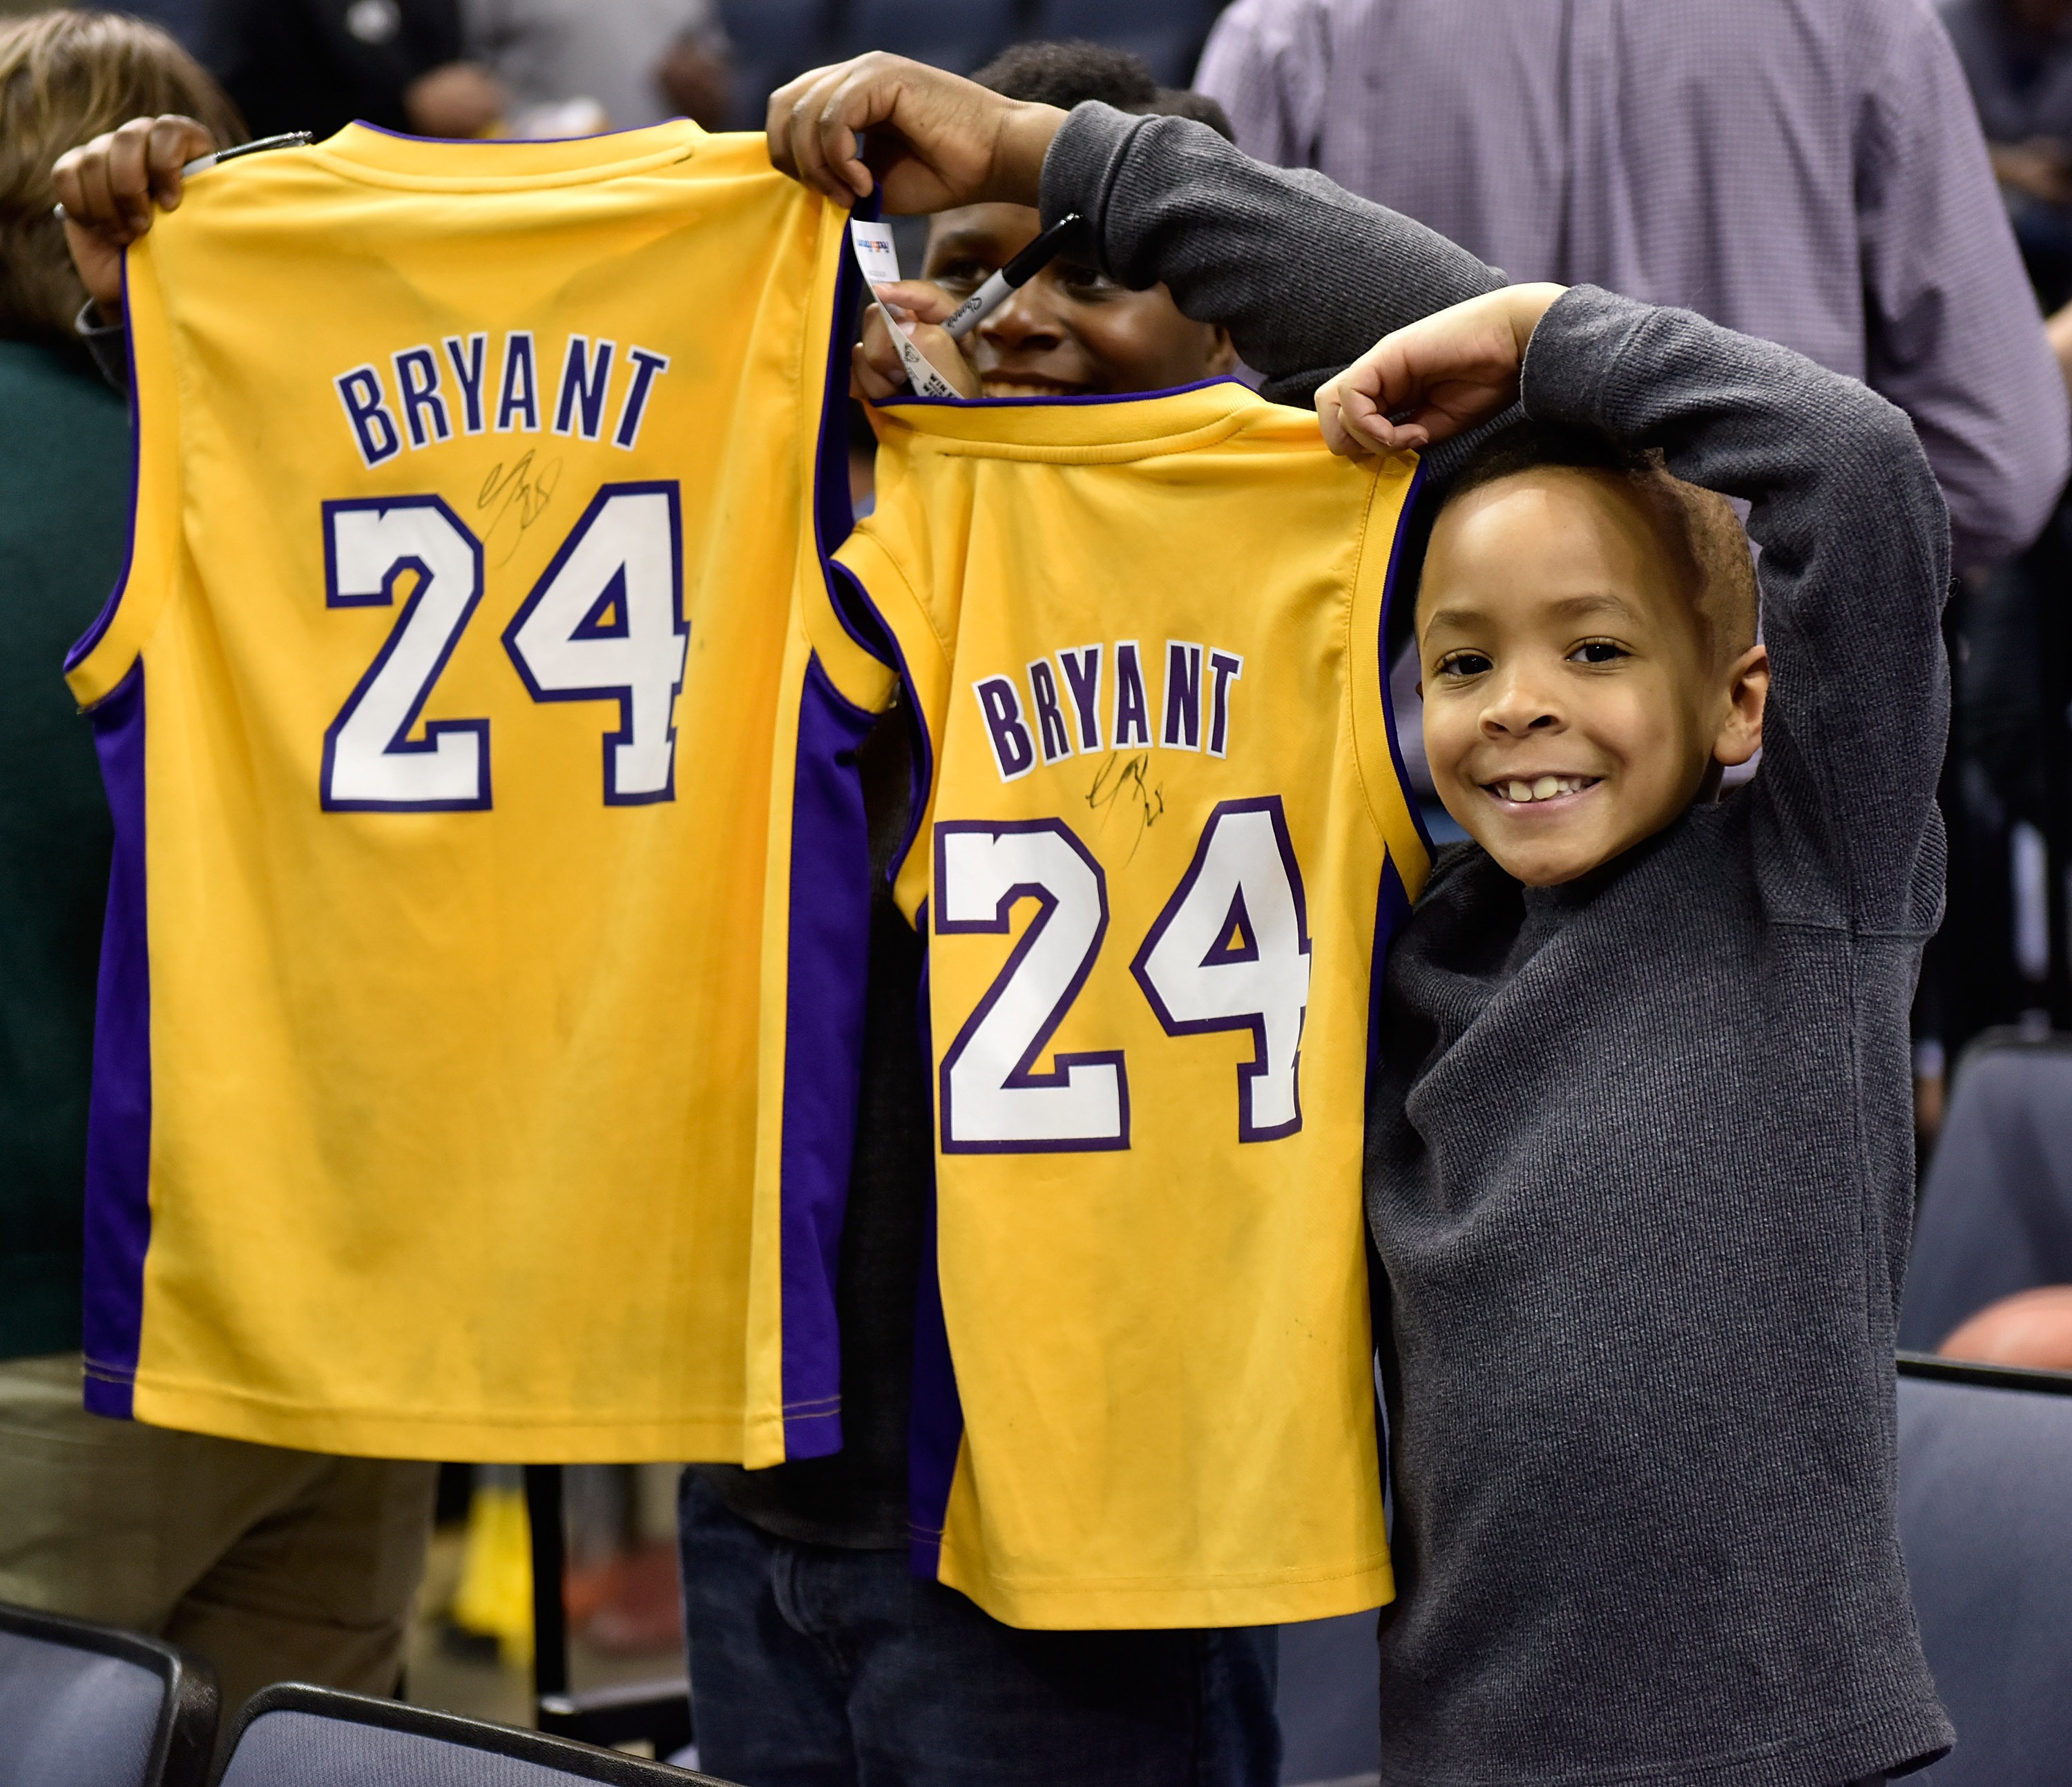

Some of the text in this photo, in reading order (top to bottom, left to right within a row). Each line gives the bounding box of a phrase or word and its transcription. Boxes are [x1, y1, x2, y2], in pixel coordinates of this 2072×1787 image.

[333, 330, 671, 470] BRYANT
[319, 479, 691, 813] 24
[972, 639, 1244, 783] BRYANT
[934, 795, 1313, 1155] 24
